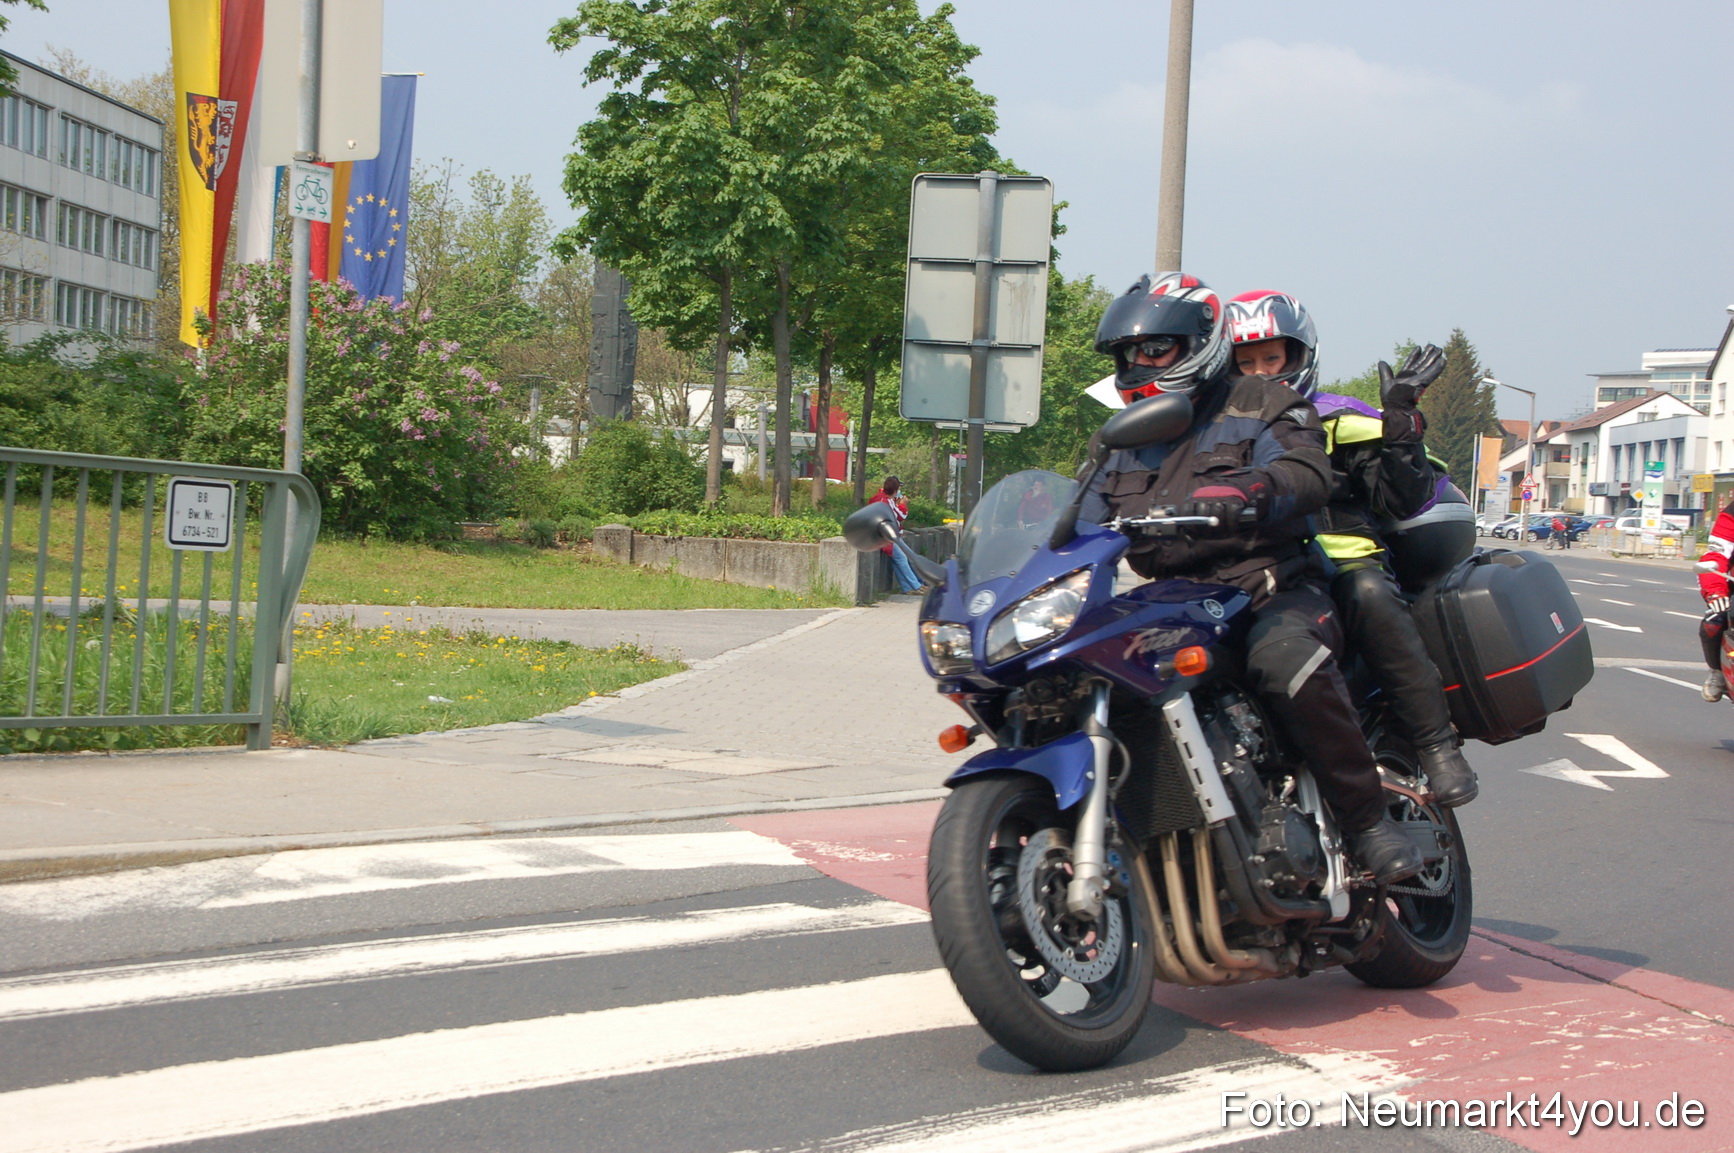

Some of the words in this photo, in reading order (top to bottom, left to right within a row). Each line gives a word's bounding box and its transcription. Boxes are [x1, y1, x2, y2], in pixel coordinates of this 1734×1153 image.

[188, 507, 202, 520] Bw.
[204, 509, 215, 521] Nr.
[182, 525, 219, 539] 6734-521
